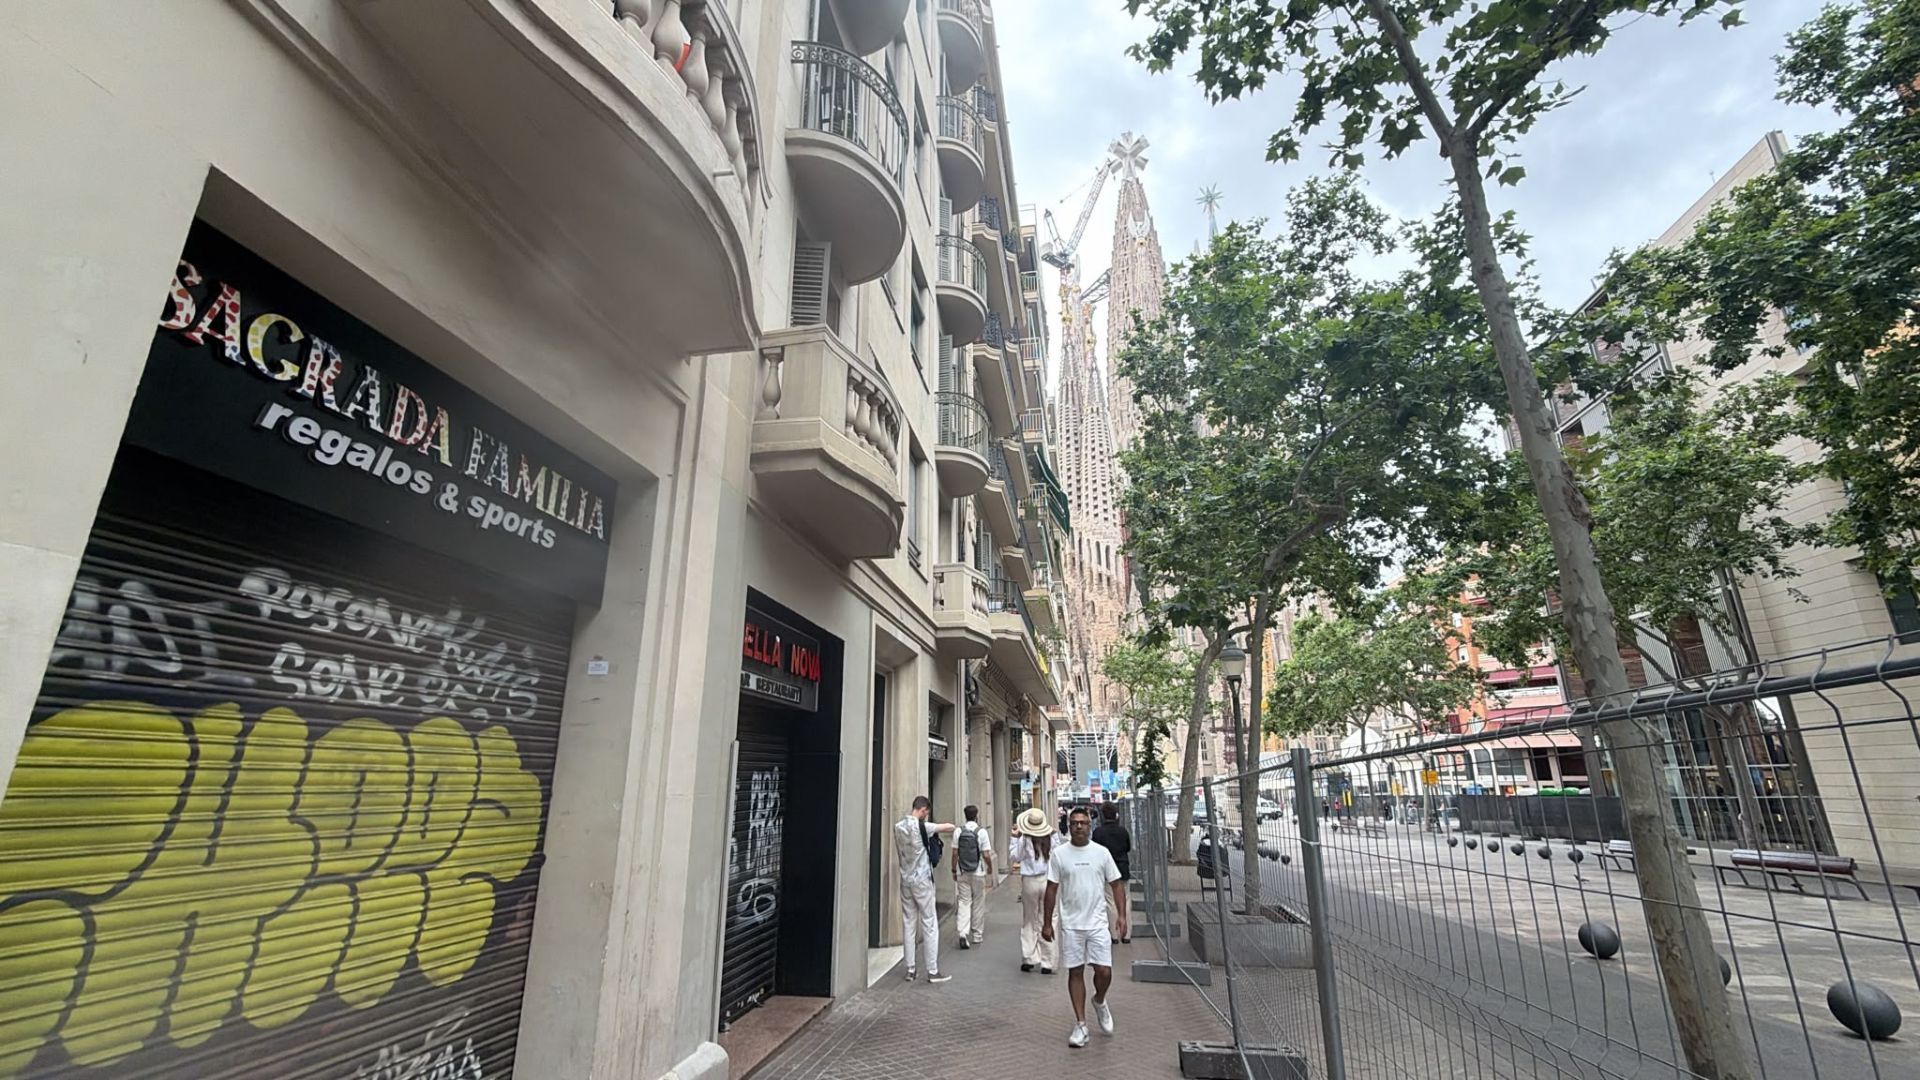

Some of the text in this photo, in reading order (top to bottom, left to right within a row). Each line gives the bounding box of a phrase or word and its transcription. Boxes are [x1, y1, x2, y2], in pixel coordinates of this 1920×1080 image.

[158, 259, 606, 541] SAGRADA FAMILIA
[260, 402, 557, 549] regalos & sports
[791, 644, 822, 682] NOVA
